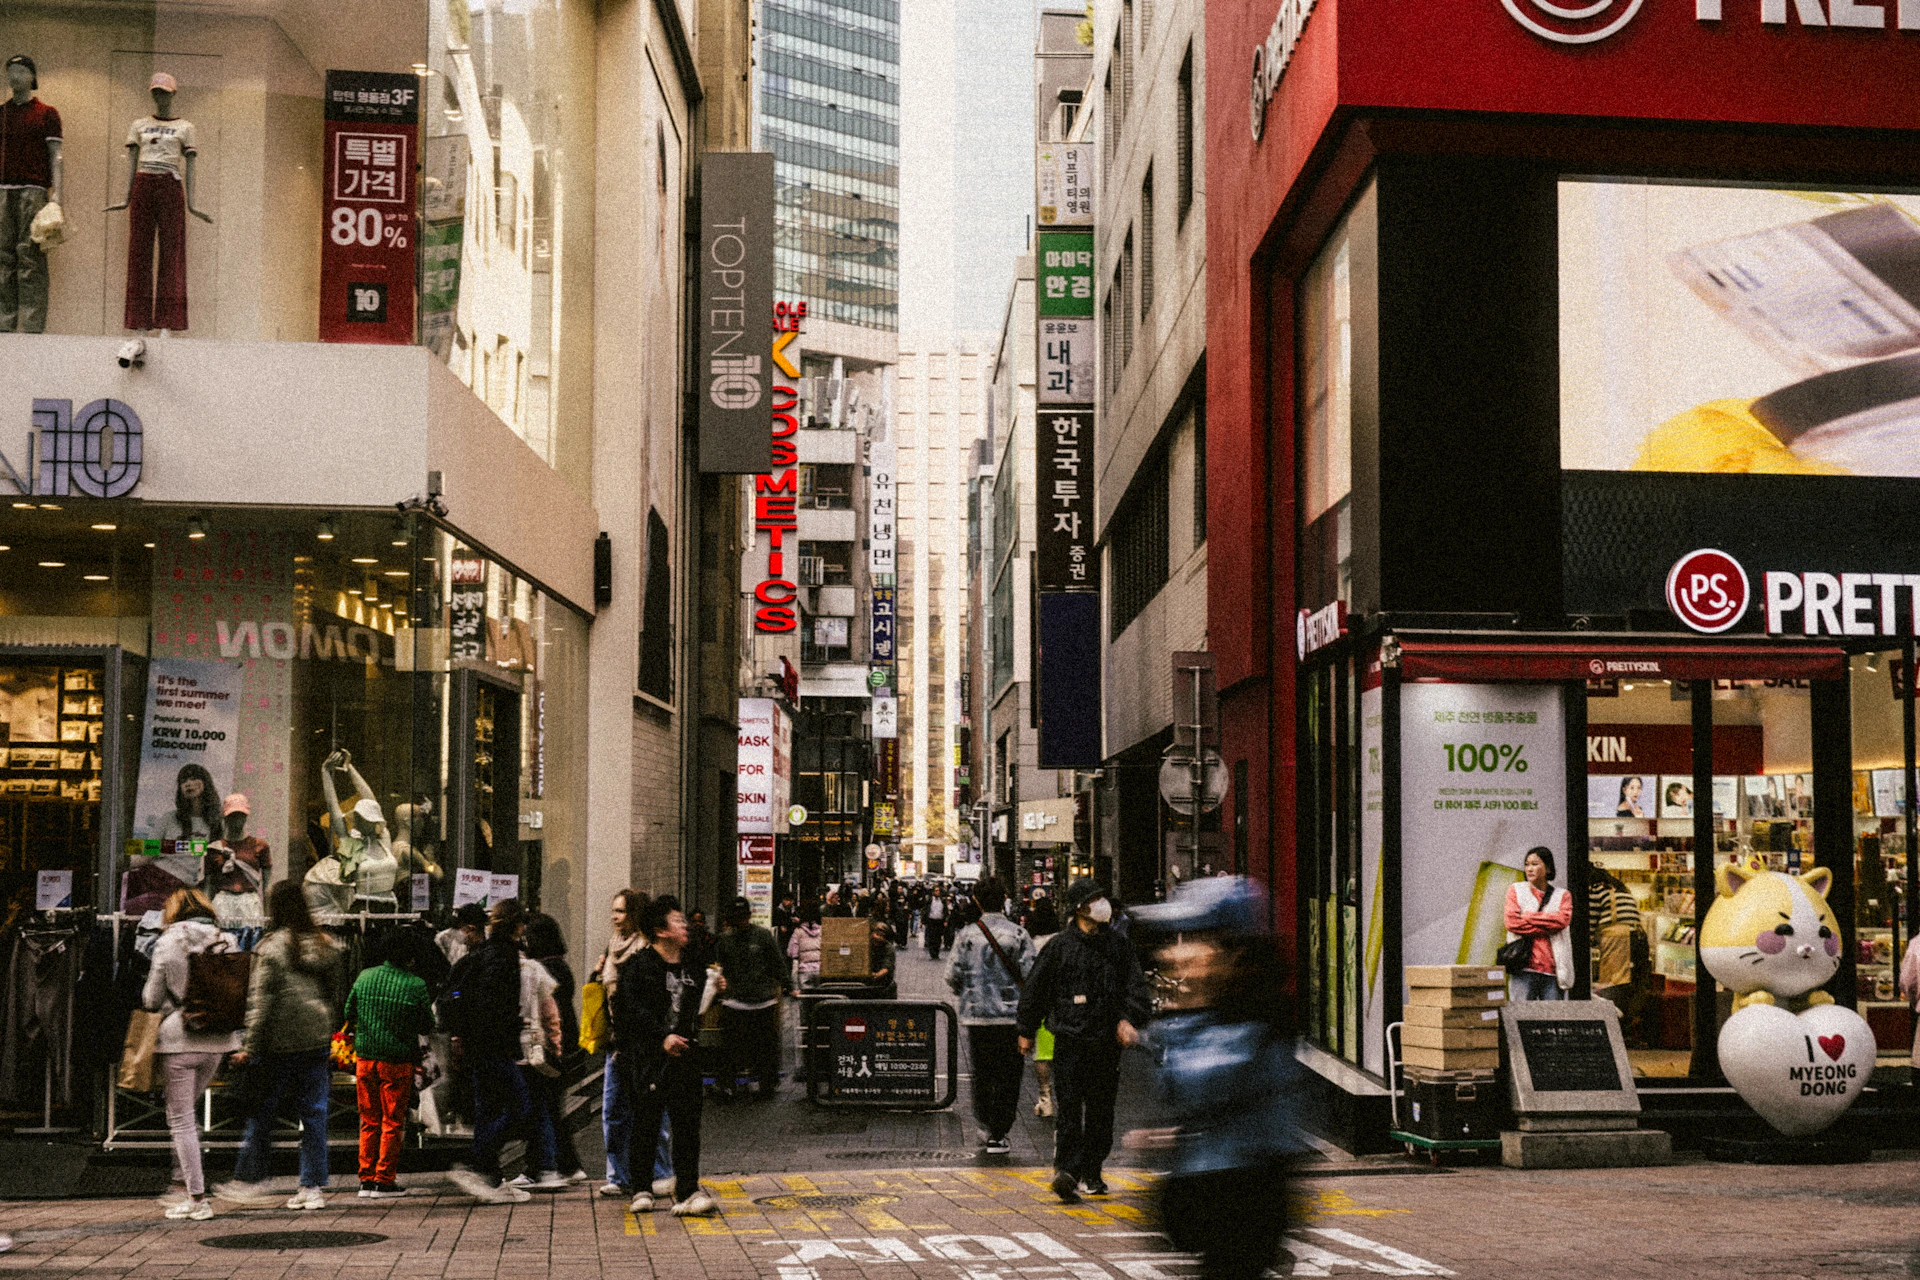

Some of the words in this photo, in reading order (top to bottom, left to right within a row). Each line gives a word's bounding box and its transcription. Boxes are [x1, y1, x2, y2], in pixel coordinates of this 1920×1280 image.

[391, 88, 414, 106] 3F
[344, 139, 397, 167] 특별
[344, 169, 396, 197] 가격
[330, 207, 407, 249] 80%
[1045, 275, 1092, 299] 안경
[354, 288, 380, 311] 10
[1047, 340, 1074, 395] 내과
[1052, 417, 1082, 540] 한국투자
[873, 472, 892, 566] 유천냉면
[1069, 545, 1086, 581] 증권
[157, 675, 174, 685] It's
[177, 677, 197, 687] the
[156, 686, 178, 696] first
[180, 689, 230, 700] summer
[156, 699, 173, 707] we
[175, 701, 206, 709] meet
[152, 727, 182, 738] KRW
[151, 738, 207, 751] discount
[738, 764, 764, 775] FOR
[1443, 743, 1529, 773] 100%
[737, 793, 767, 804] SKIN
[1804, 1034, 1815, 1063] I
[1790, 1064, 1857, 1081] MYEONG
[1801, 1081, 1847, 1097] DONG
